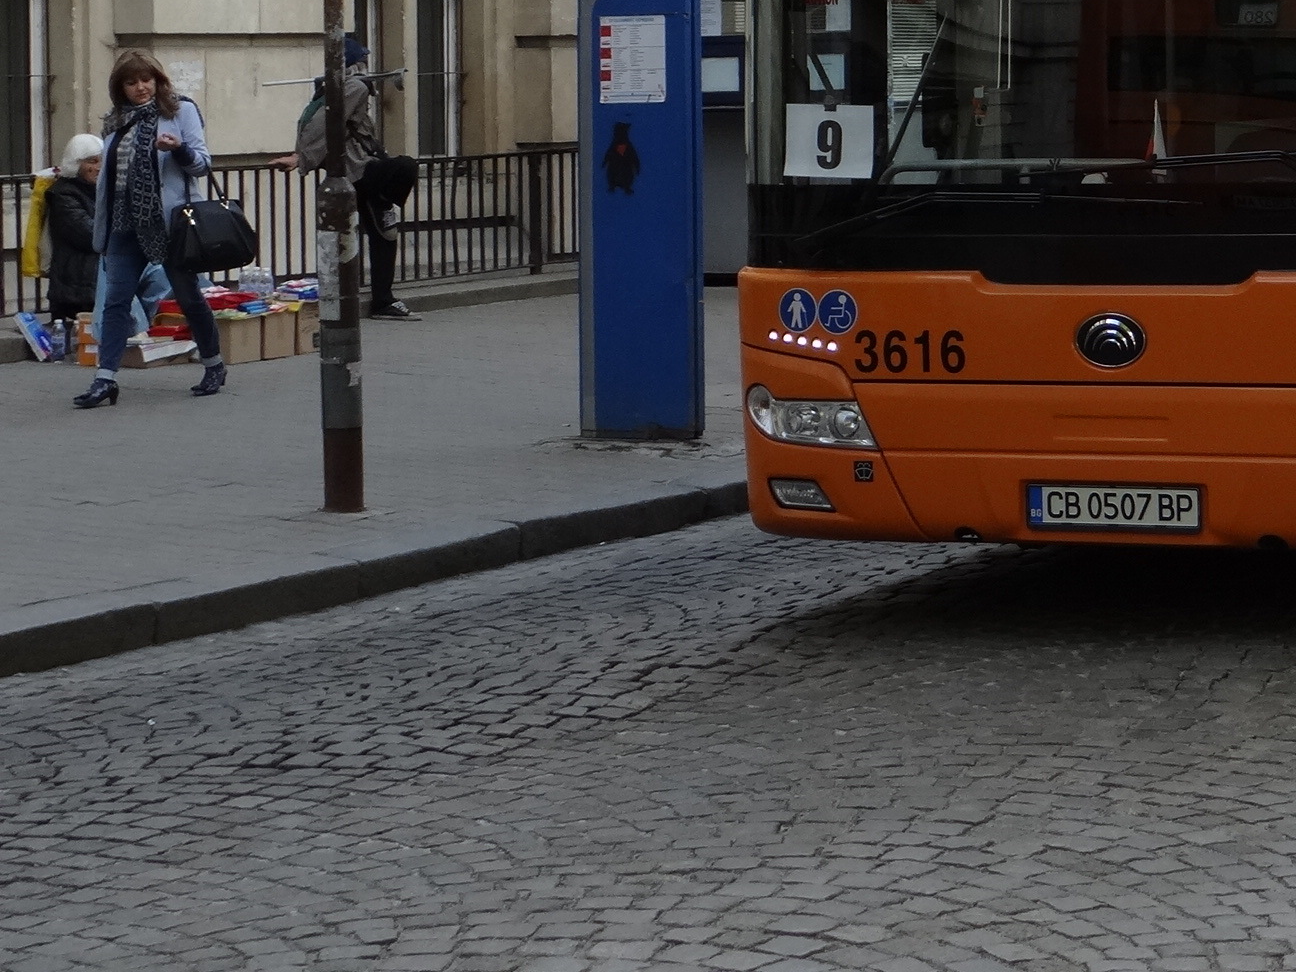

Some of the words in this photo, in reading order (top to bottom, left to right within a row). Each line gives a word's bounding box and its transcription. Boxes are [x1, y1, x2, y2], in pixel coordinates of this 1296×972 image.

[815, 119, 843, 170] 9
[854, 329, 966, 374] 3616
[1030, 508, 1043, 518] BG
[1087, 492, 1153, 521] 0507
